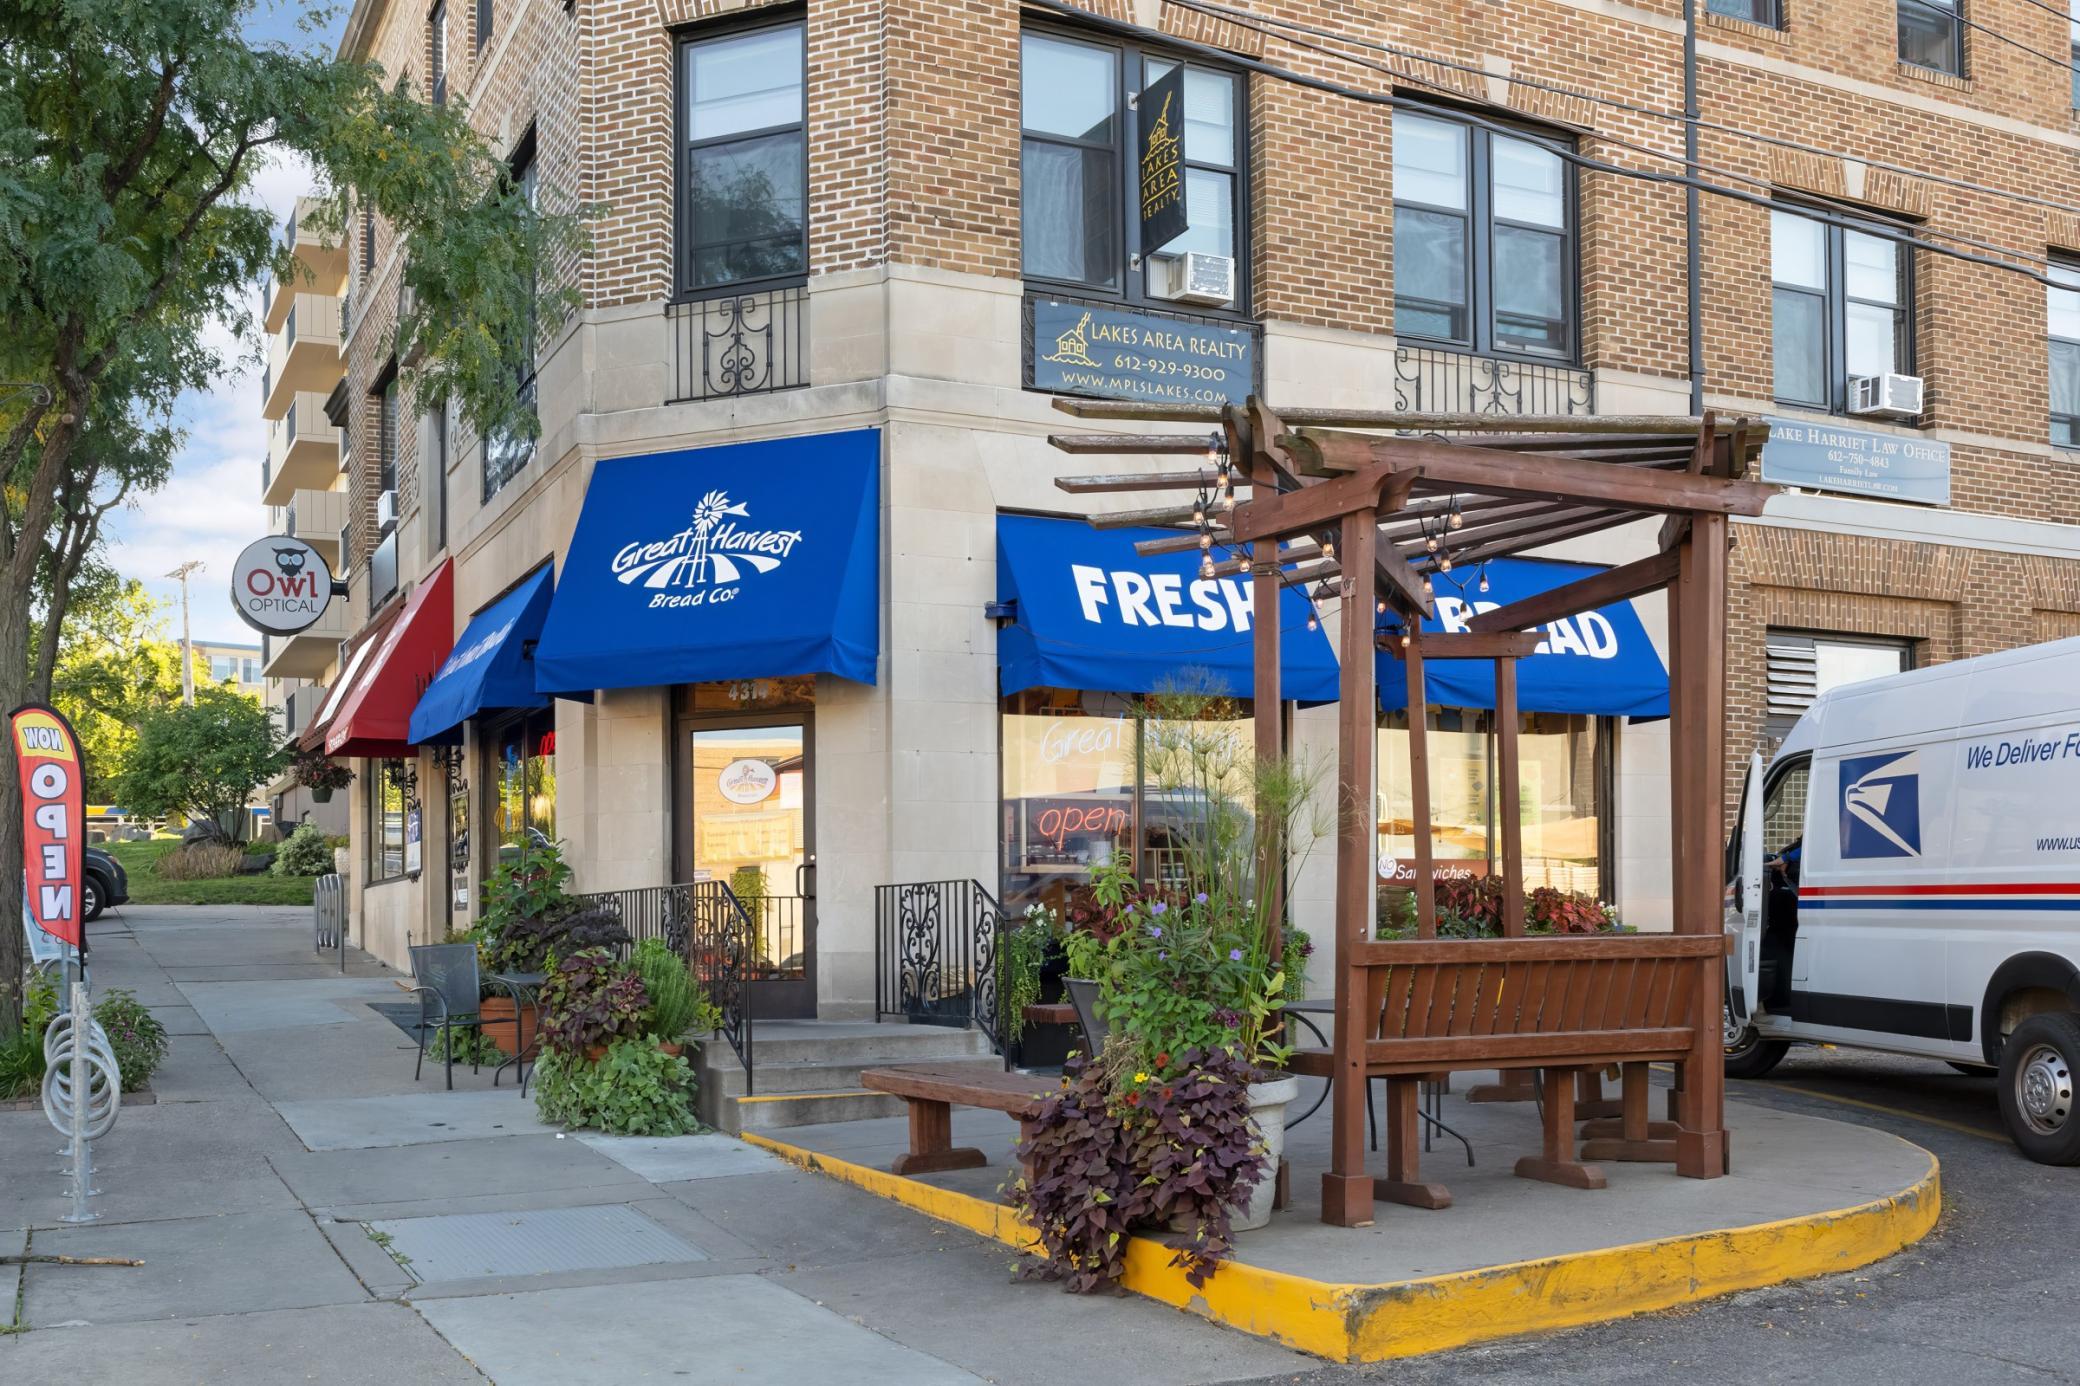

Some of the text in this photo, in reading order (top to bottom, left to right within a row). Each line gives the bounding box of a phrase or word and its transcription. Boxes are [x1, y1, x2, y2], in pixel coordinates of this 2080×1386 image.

[1142, 145, 1178, 180] LAKES
[1143, 168, 1178, 202] AREA
[1092, 322, 1247, 361] LAKES AREA REALTY
[1114, 355, 1226, 382] 612-929-9300
[1062, 371, 1228, 403] WWW.MPLSLAKES.COM
[1769, 426, 1946, 464] LAKE HARRIET LAW OFFICE
[1839, 465, 1864, 478] Family
[612, 522, 802, 573] Great Harvest
[246, 568, 319, 599] Owl
[648, 589, 706, 608] Bread
[1071, 564, 1255, 633] FRESH
[248, 598, 318, 613] OPTICAL
[1039, 712, 1124, 763] Great
[1967, 745, 1993, 769] We
[1995, 738, 2061, 766] Deliver
[1039, 806, 1126, 852] open
